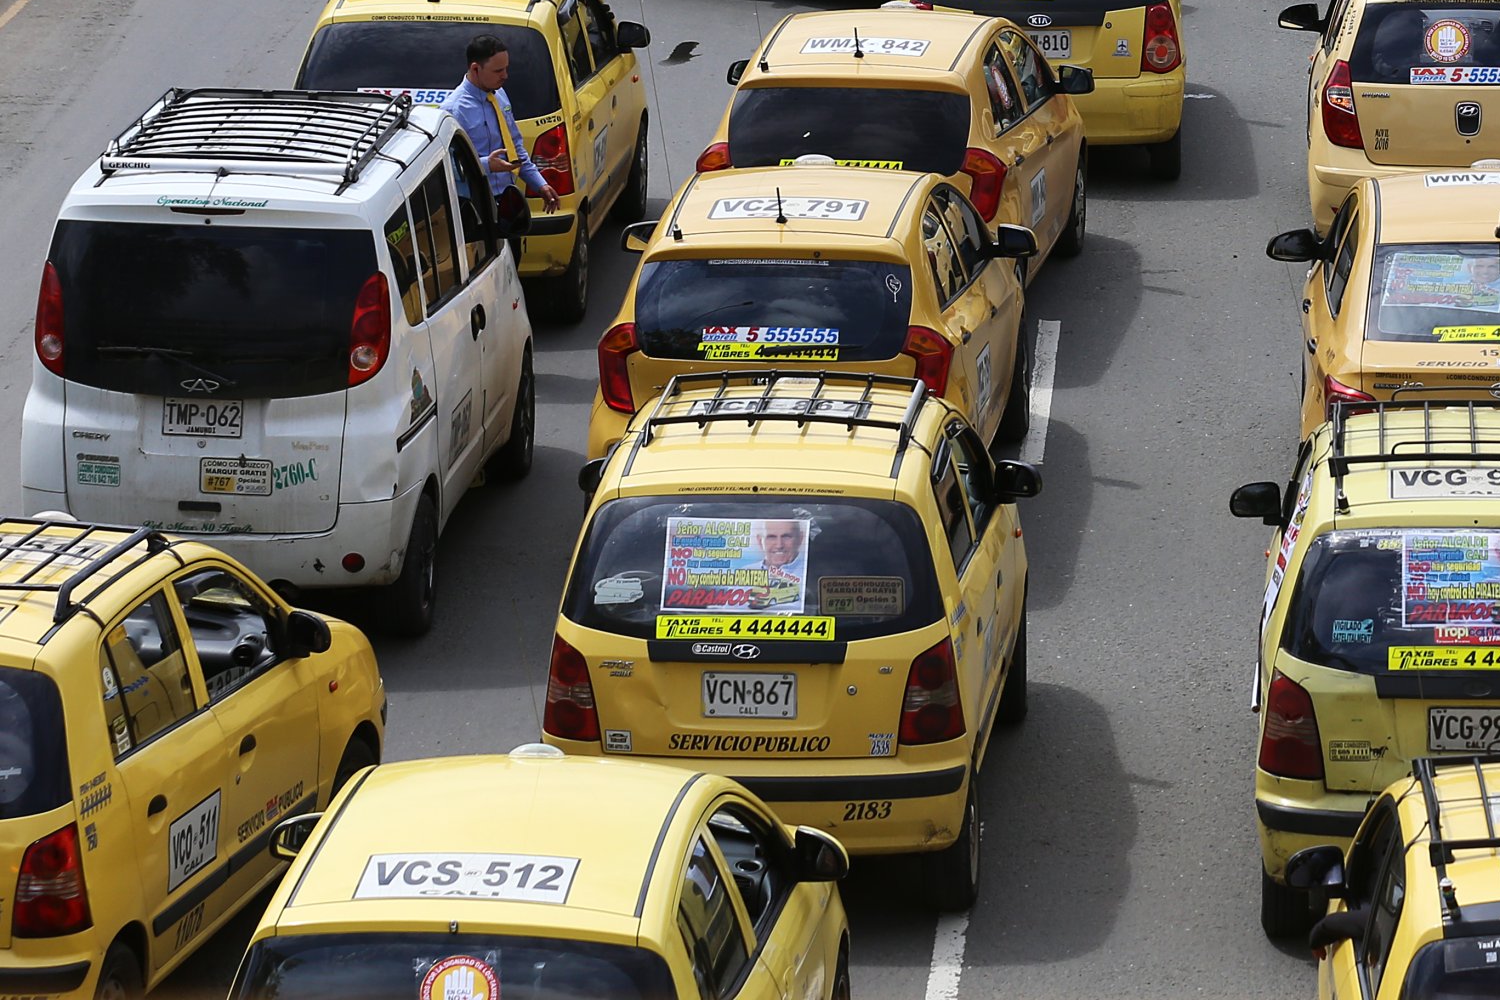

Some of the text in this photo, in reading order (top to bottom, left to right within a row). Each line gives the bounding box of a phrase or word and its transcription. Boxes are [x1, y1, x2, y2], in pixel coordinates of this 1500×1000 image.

[1031, 16, 1048, 25] KIA
[1411, 67, 1445, 75] TAX
[1374, 138, 1390, 151] 2016
[108, 161, 151, 169] GERCHIG
[157, 195, 269, 209] Operacion Nacional
[764, 327, 839, 343] 555555
[186, 426, 217, 435] JAMUNDI
[73, 431, 111, 442] CHERY
[205, 468, 267, 477] MARQUE GRATIS
[272, 458, 319, 490] 2760-C
[208, 476, 261, 487] #767 Opción
[201, 522, 215, 531] 80
[676, 521, 752, 536] Señor ALCALDE
[728, 538, 751, 548] CALI
[1412, 536, 1488, 550] Señor ALCALDE
[671, 548, 743, 559] NO seguridad
[1465, 550, 1488, 560] CALI
[1408, 562, 1431, 573] NO
[668, 567, 723, 586] NO control
[1407, 582, 1427, 600] NO
[666, 588, 753, 607] PARAMOS
[667, 619, 702, 627] TAXIS
[681, 619, 829, 638] LIBRES 4 444444
[702, 644, 729, 654] Castrol
[1399, 649, 1435, 659] TAXIS
[1414, 650, 1479, 667] LIBRES 4
[739, 706, 759, 715] CALI
[668, 734, 832, 753] SERVICIO PUBLICO
[1466, 741, 1486, 749] CALI
[237, 780, 304, 843] SERVICIO PUBLICO
[843, 801, 893, 822] 2183
[183, 854, 204, 876] CALI
